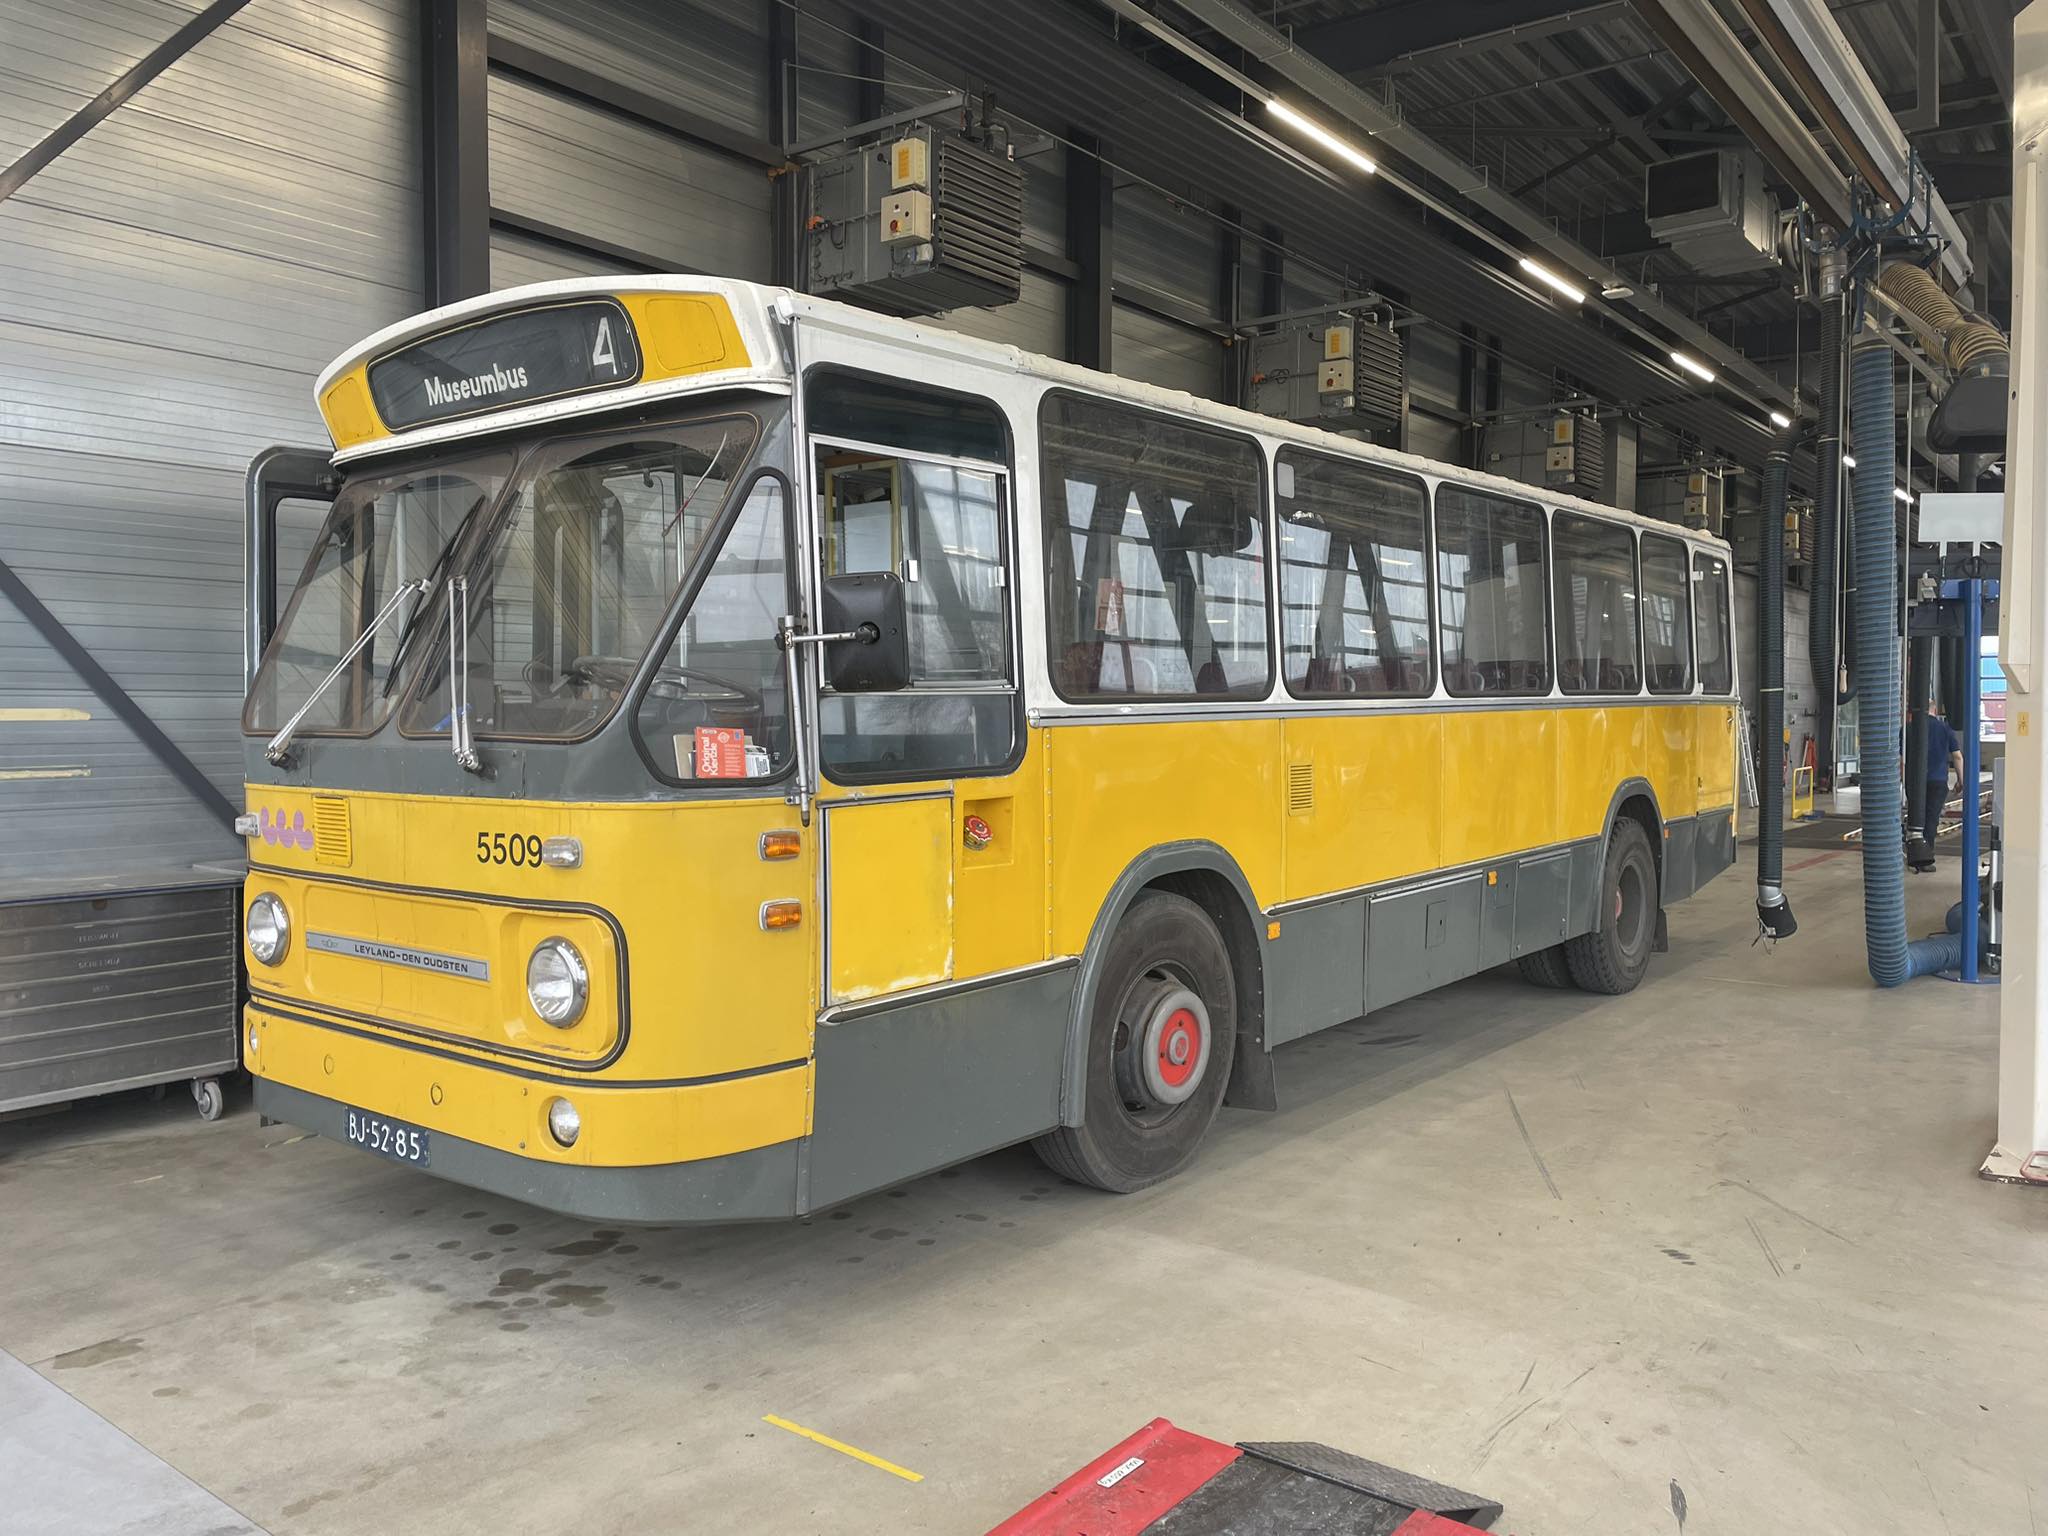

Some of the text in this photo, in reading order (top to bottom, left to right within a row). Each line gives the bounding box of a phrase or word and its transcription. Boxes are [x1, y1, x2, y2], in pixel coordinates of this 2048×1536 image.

[592, 316, 618, 375] 4
[423, 362, 528, 407] Museumbus
[701, 736, 712, 773] Original
[710, 743, 719, 776] Kienzle
[477, 831, 543, 868] 5509
[423, 956, 469, 974] OUDSTEN
